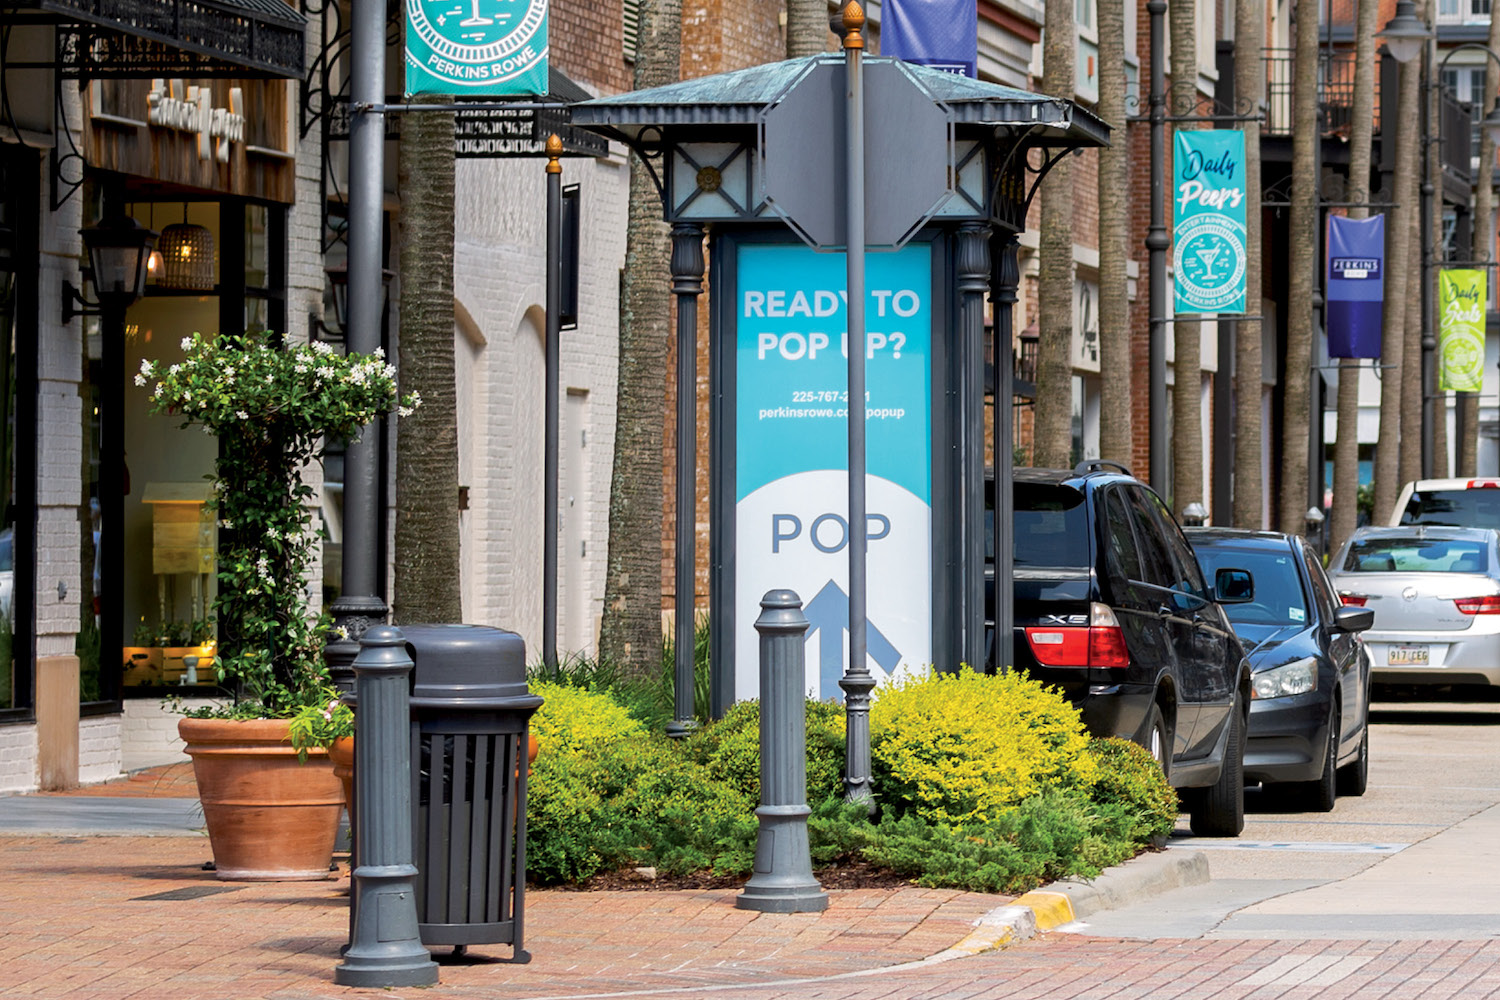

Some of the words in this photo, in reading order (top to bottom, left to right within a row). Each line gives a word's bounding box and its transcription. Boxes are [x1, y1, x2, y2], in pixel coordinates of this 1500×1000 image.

[427, 53, 489, 79] PERKINS
[490, 45, 537, 77] ROWE
[1182, 150, 1237, 181] Daily
[1176, 180, 1244, 215] Peeps
[1334, 260, 1378, 270] PERKINS
[871, 289, 921, 317] TO
[1185, 292, 1216, 306] PERKINS
[1444, 283, 1480, 303] Daily
[758, 332, 830, 360] POP
[792, 390, 870, 402] 225-767-21
[772, 513, 891, 554] POP
[1391, 650, 1407, 660] 917
